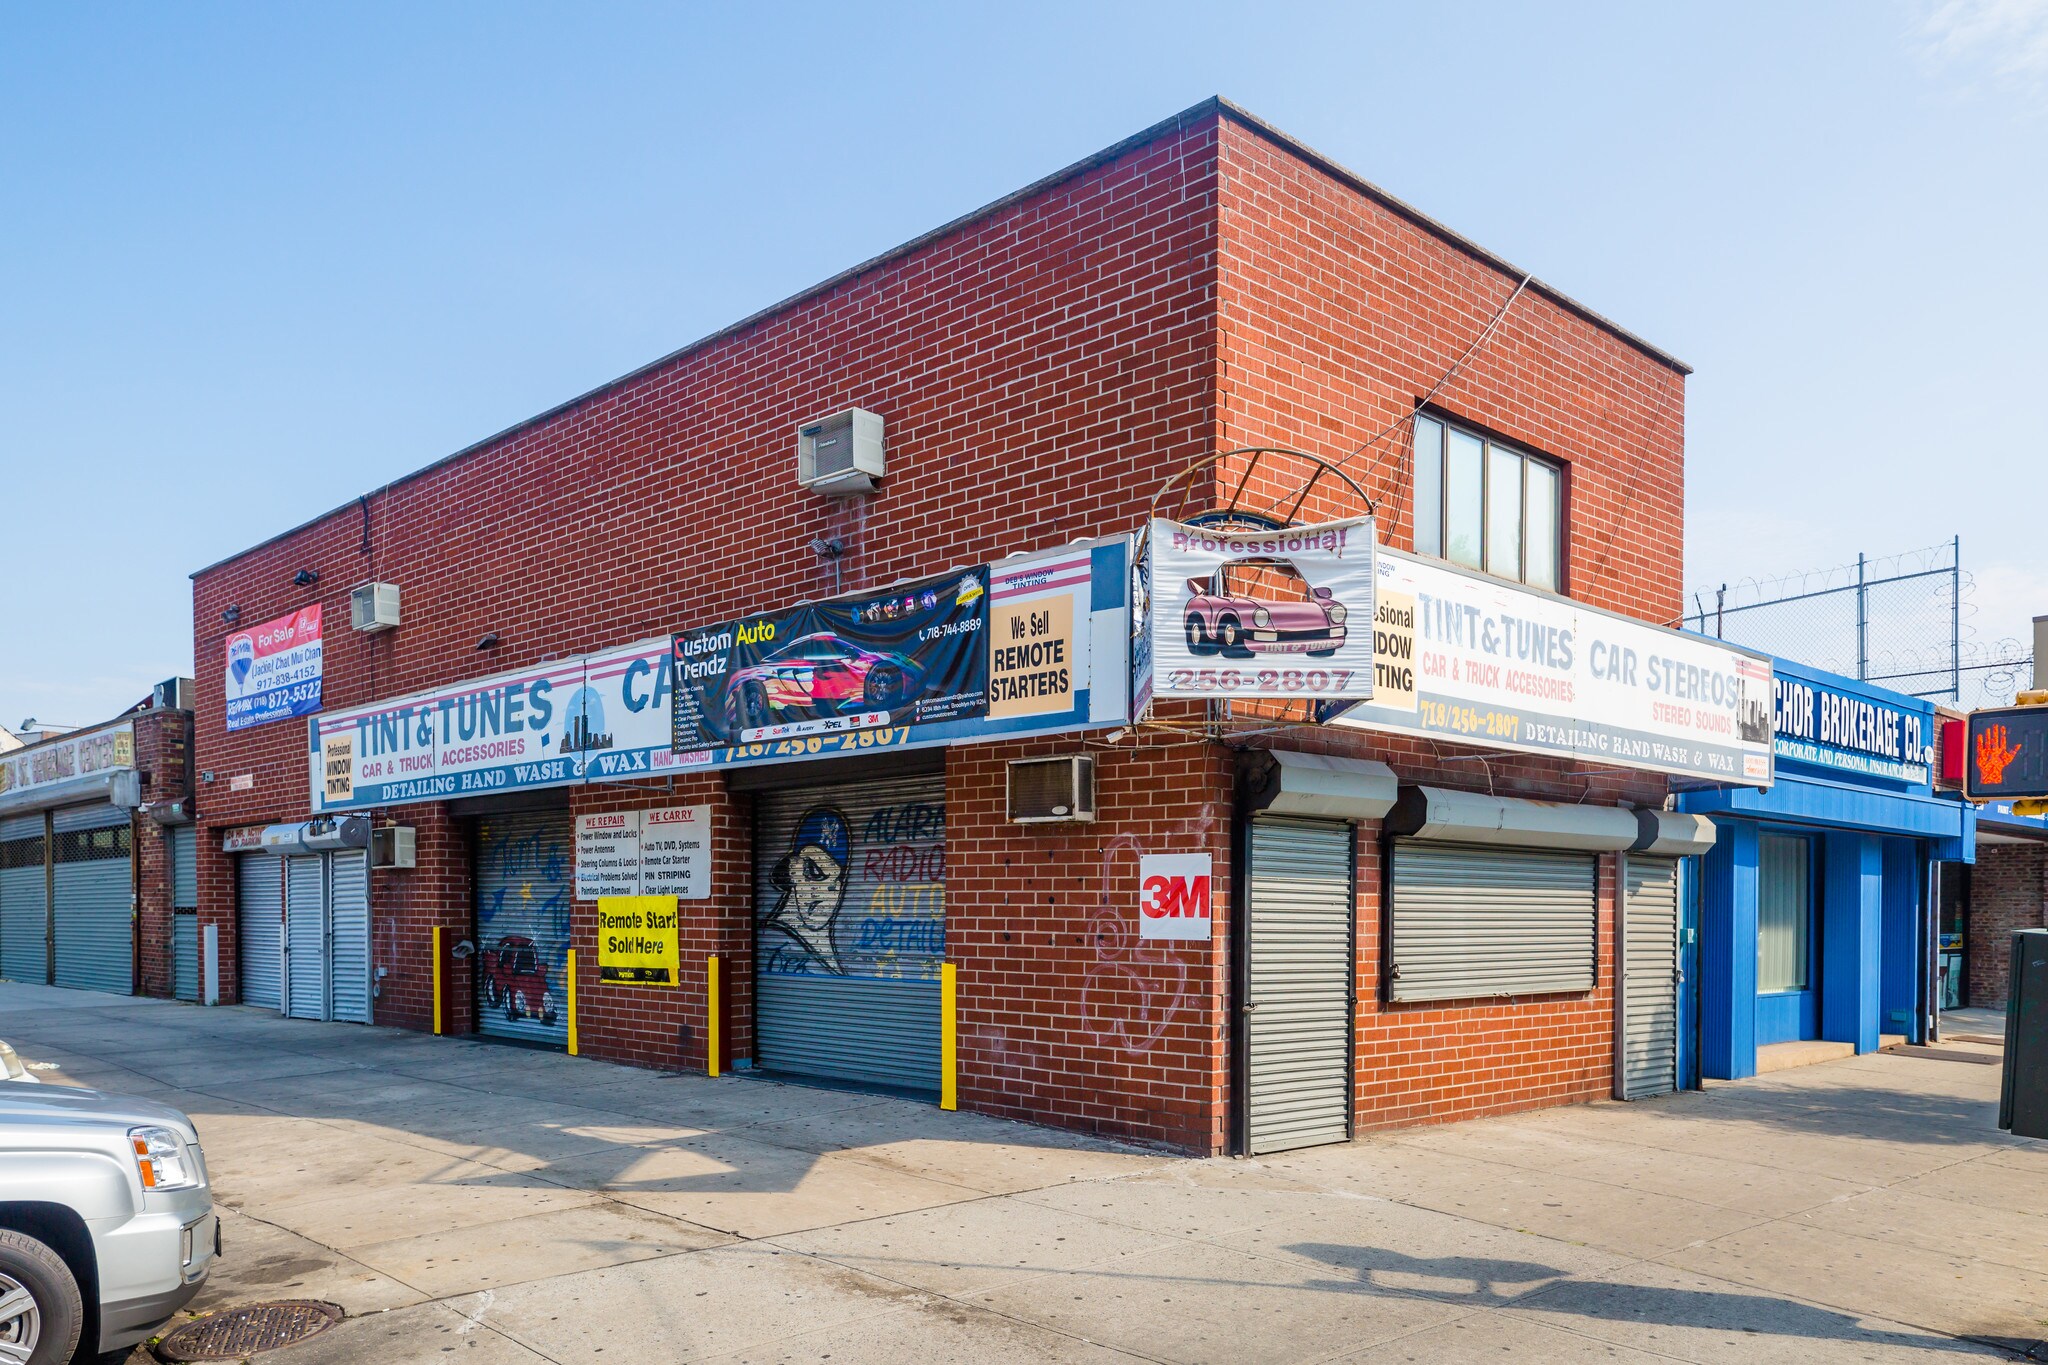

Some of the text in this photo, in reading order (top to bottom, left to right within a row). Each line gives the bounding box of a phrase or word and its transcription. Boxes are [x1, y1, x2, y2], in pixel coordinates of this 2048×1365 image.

[1172, 527, 1348, 554] Professional
[1005, 568, 1054, 585] DEB'S WINDOW
[1012, 578, 1047, 590] TINTING
[926, 618, 982, 640] 718-744-8889
[1011, 610, 1050, 640] We Sell
[258, 626, 294, 648] For Sale
[675, 620, 775, 659] Custom Auto
[1264, 643, 1289, 652] TINT
[1306, 640, 1338, 651] TUNES
[994, 638, 1064, 672] REMOTE
[256, 664, 316, 690] 917-838-4152
[674, 654, 726, 682] Trendz
[1422, 651, 1574, 703] CAR & TRUCK ACCESSORIES
[1590, 639, 1738, 710] CAR STEREOS
[991, 668, 1069, 703] STARTERS
[1168, 668, 1355, 692] 256-2807
[268, 680, 322, 710] 872-5522
[227, 718, 240, 730] Real
[255, 706, 293, 722] Professionals
[868, 712, 878, 724] 3M
[1420, 699, 1518, 742] 718/256-2807
[1652, 701, 1732, 735] STEREO SOUNDS
[1774, 678, 1924, 763] CHOR BROKERAGE CO.
[327, 740, 352, 758] Professional
[1526, 722, 1608, 752] DETAILING
[1613, 736, 1651, 759] HAND
[1652, 742, 1688, 764] WASH
[1694, 750, 1702, 766] &
[1708, 752, 1734, 772] WAX
[1774, 738, 1818, 760] CORPORATE
[1819, 748, 1834, 764] AND
[1834, 752, 1869, 772] PERSONAL
[326, 758, 352, 776] WINDOW
[362, 738, 526, 779] CAR & TRUCK ACCESSORIES
[653, 750, 710, 767] HAND WASHED
[382, 751, 647, 800] DETAILING HAND WASH & WAX
[327, 778, 350, 796] TINTING
[586, 815, 626, 827] WE REPAIR
[650, 810, 693, 822] WE CARRY
[580, 830, 638, 840] Power Window and Locks
[580, 845, 615, 855] Power Antennas
[644, 840, 700, 853] Auto TV, DVD, Systems
[580, 860, 598, 870] Steering
[598, 859, 618, 868] Columns
[624, 858, 638, 866] Locks
[644, 855, 690, 866] Remote Car Starter
[600, 872, 620, 882] Problems
[622, 872, 638, 881] Solved
[644, 870, 691, 880] PIN STRIPING
[581, 886, 631, 896] Paintless Dent Removal
[645, 885, 688, 896] Clear Light Lenses
[1141, 875, 1210, 919] 3M
[600, 911, 676, 929] Remote Start
[608, 936, 664, 954] Sold Here
